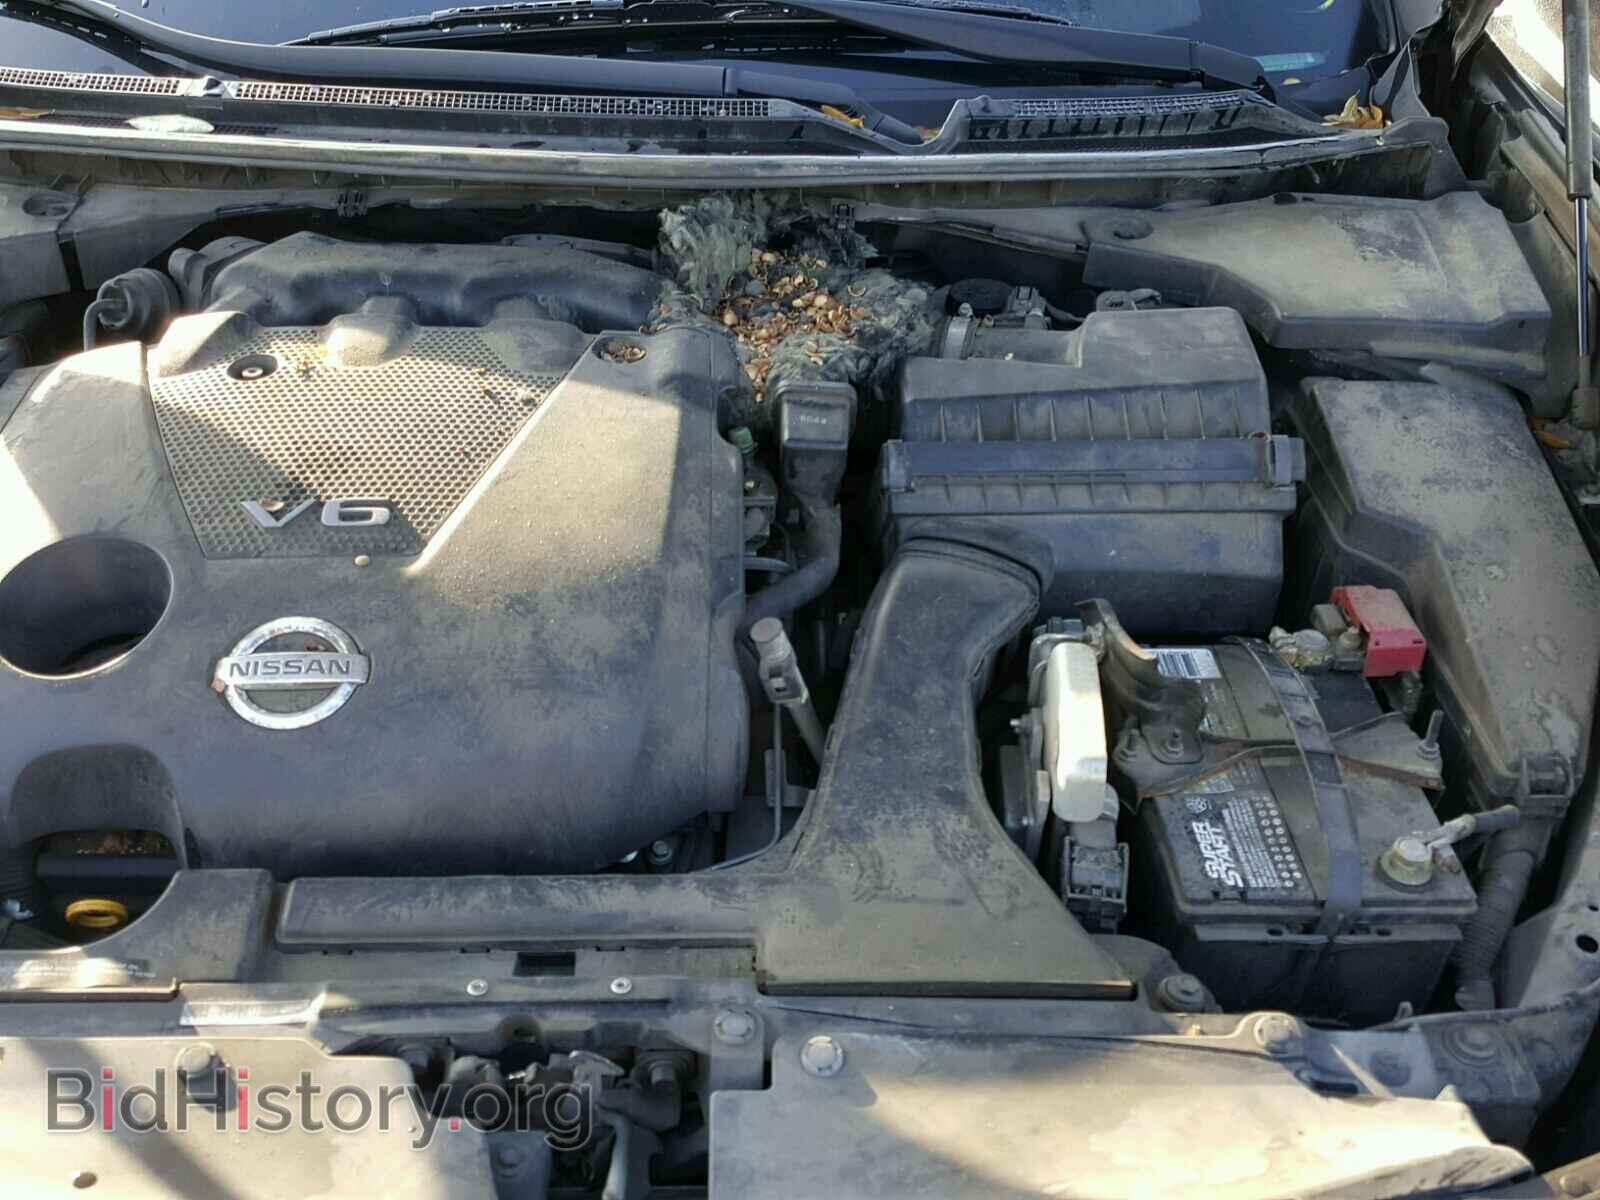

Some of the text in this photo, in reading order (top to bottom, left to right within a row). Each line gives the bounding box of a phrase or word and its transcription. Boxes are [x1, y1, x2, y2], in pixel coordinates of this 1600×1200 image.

[241, 496, 391, 528] V6
[229, 659, 351, 677] NISSAN
[1192, 821, 1221, 879] SUPER
[1209, 827, 1244, 887] START
